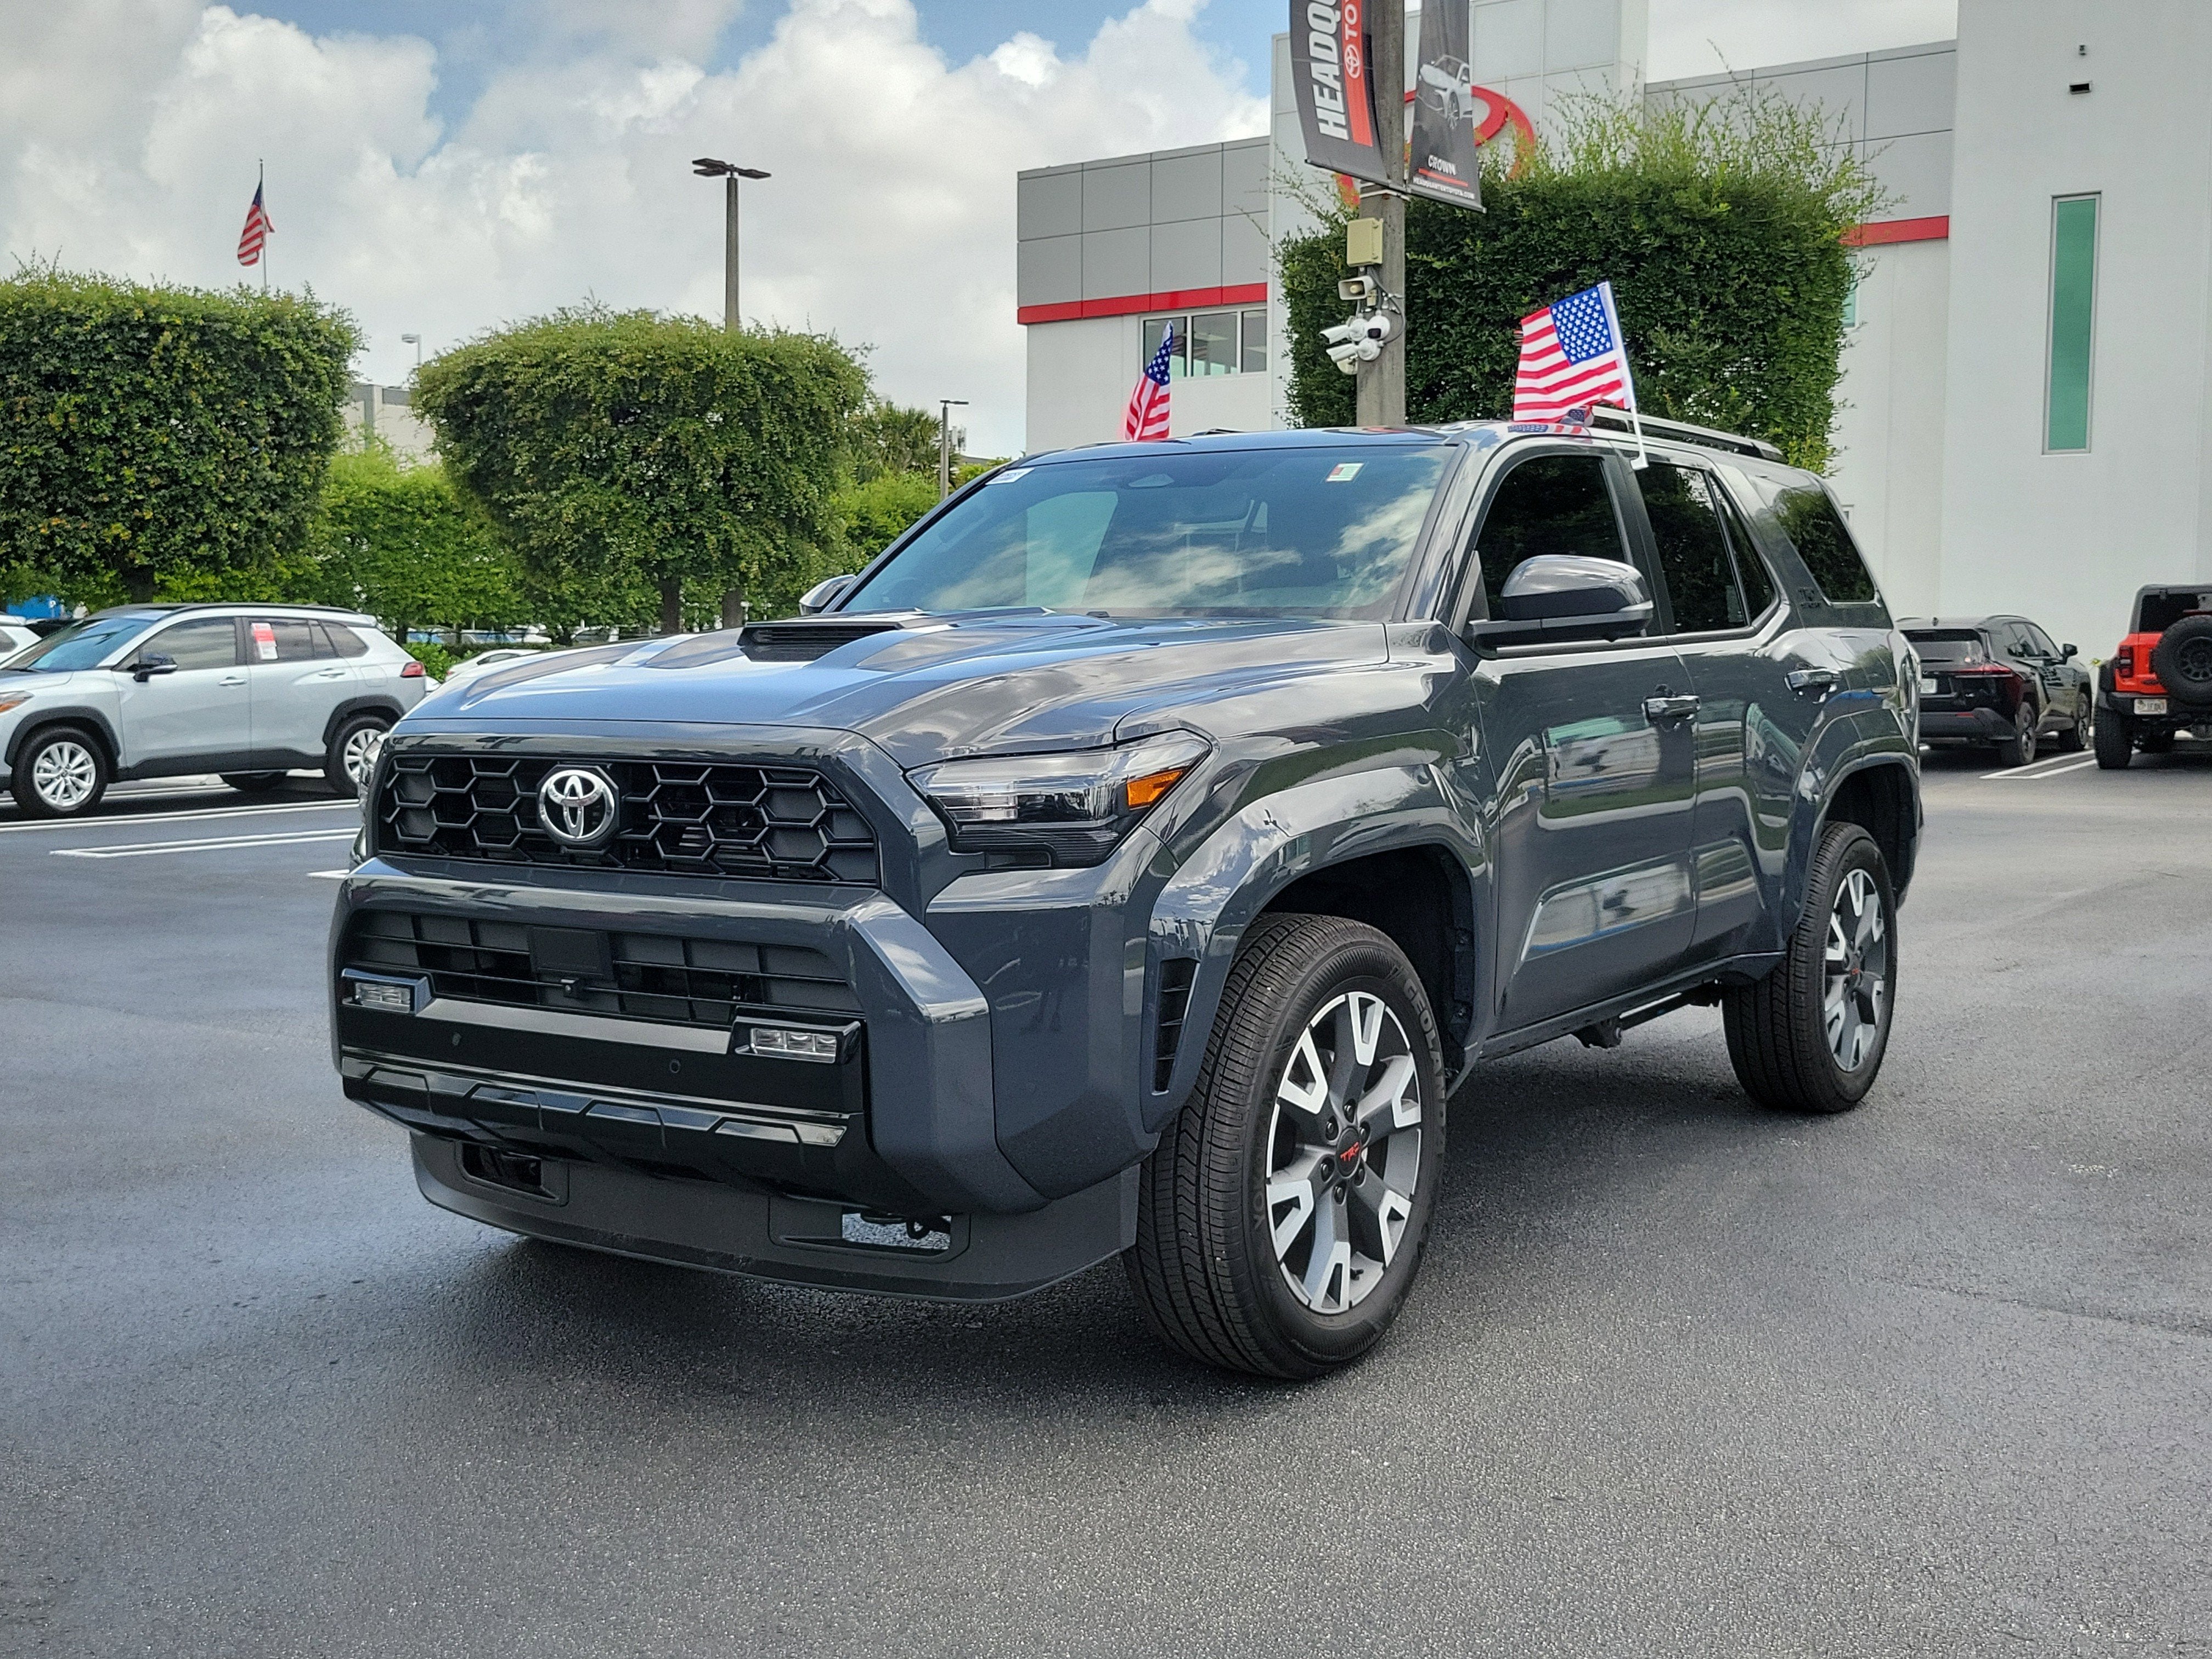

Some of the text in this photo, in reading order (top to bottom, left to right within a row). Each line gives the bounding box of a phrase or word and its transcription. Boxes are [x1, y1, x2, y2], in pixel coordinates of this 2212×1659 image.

[1345, 0, 1358, 41] TO
[1307, 0, 1349, 140] HEADQ
[1428, 155, 1456, 176] CROWN
[1403, 978, 1446, 1169] GEOLANDA
[1340, 1141, 1359, 1162] TRD
